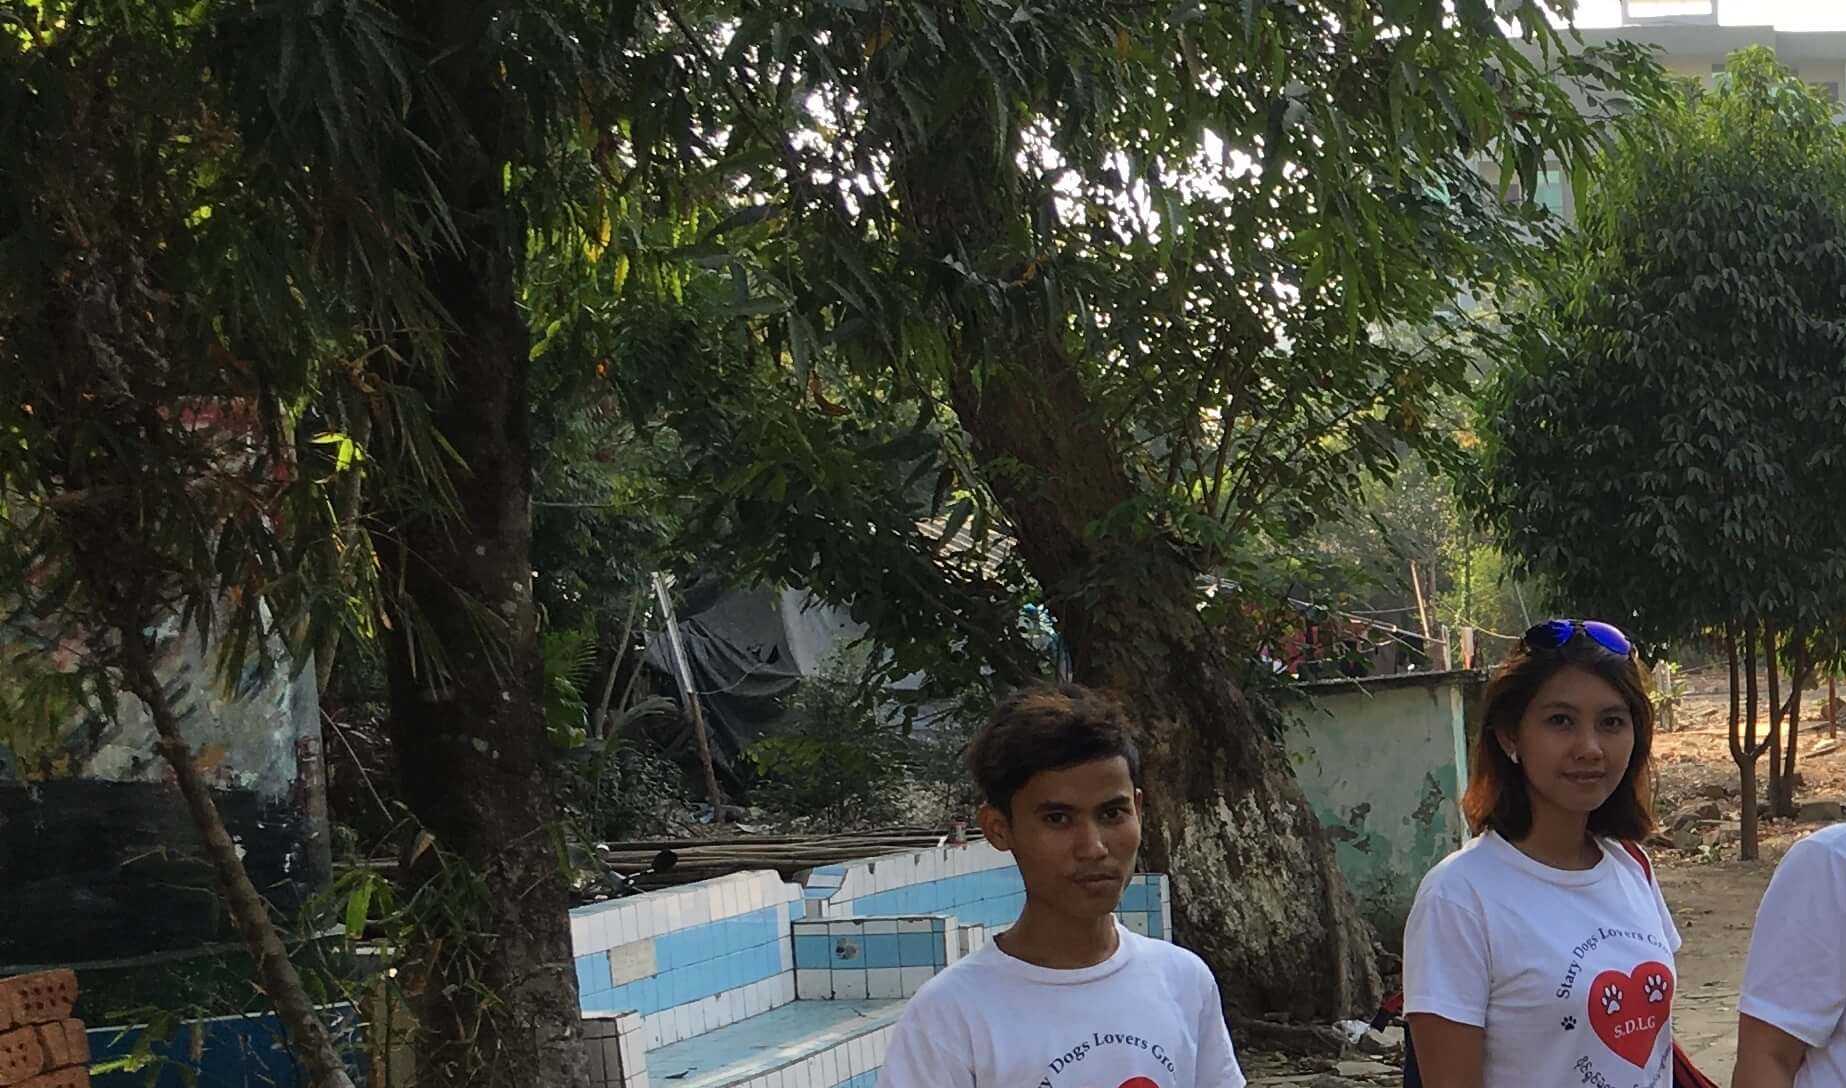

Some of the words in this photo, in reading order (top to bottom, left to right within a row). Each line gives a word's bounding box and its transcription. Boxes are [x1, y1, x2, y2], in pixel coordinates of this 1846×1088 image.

[1556, 961, 1583, 1000] Stary
[1572, 935, 1600, 960] Dogs
[1049, 1042, 1090, 1074] Dogs
[1093, 1032, 1149, 1050] Lovers
